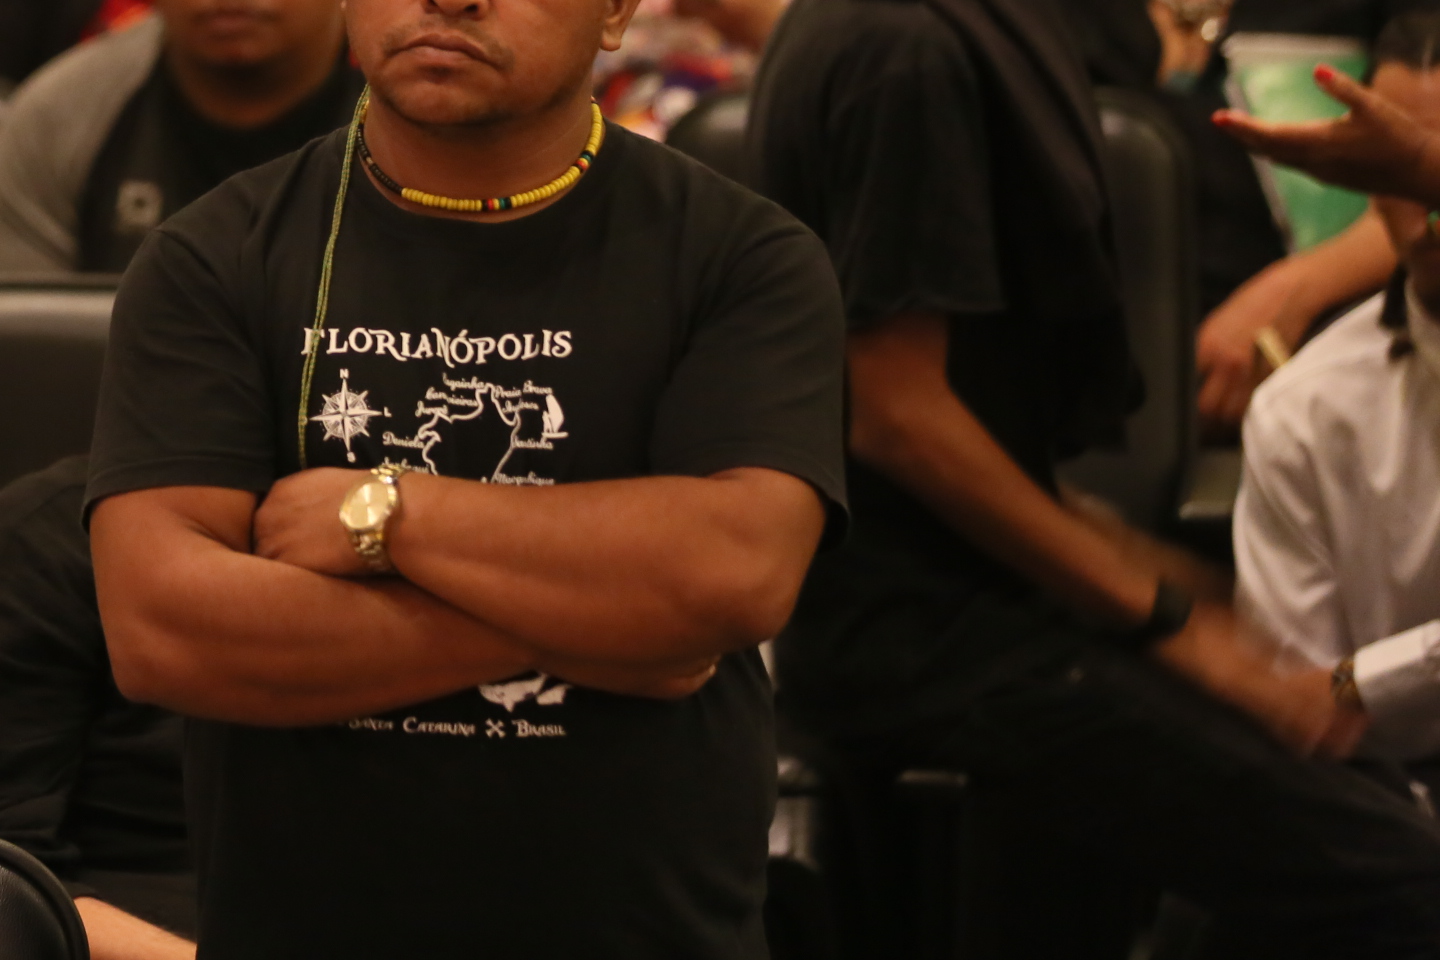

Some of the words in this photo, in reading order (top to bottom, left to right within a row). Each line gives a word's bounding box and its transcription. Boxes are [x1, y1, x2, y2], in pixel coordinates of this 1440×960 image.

[301, 327, 572, 368] FLORIANÓPOLIS
[339, 368, 350, 379] N
[383, 406, 392, 418] L
